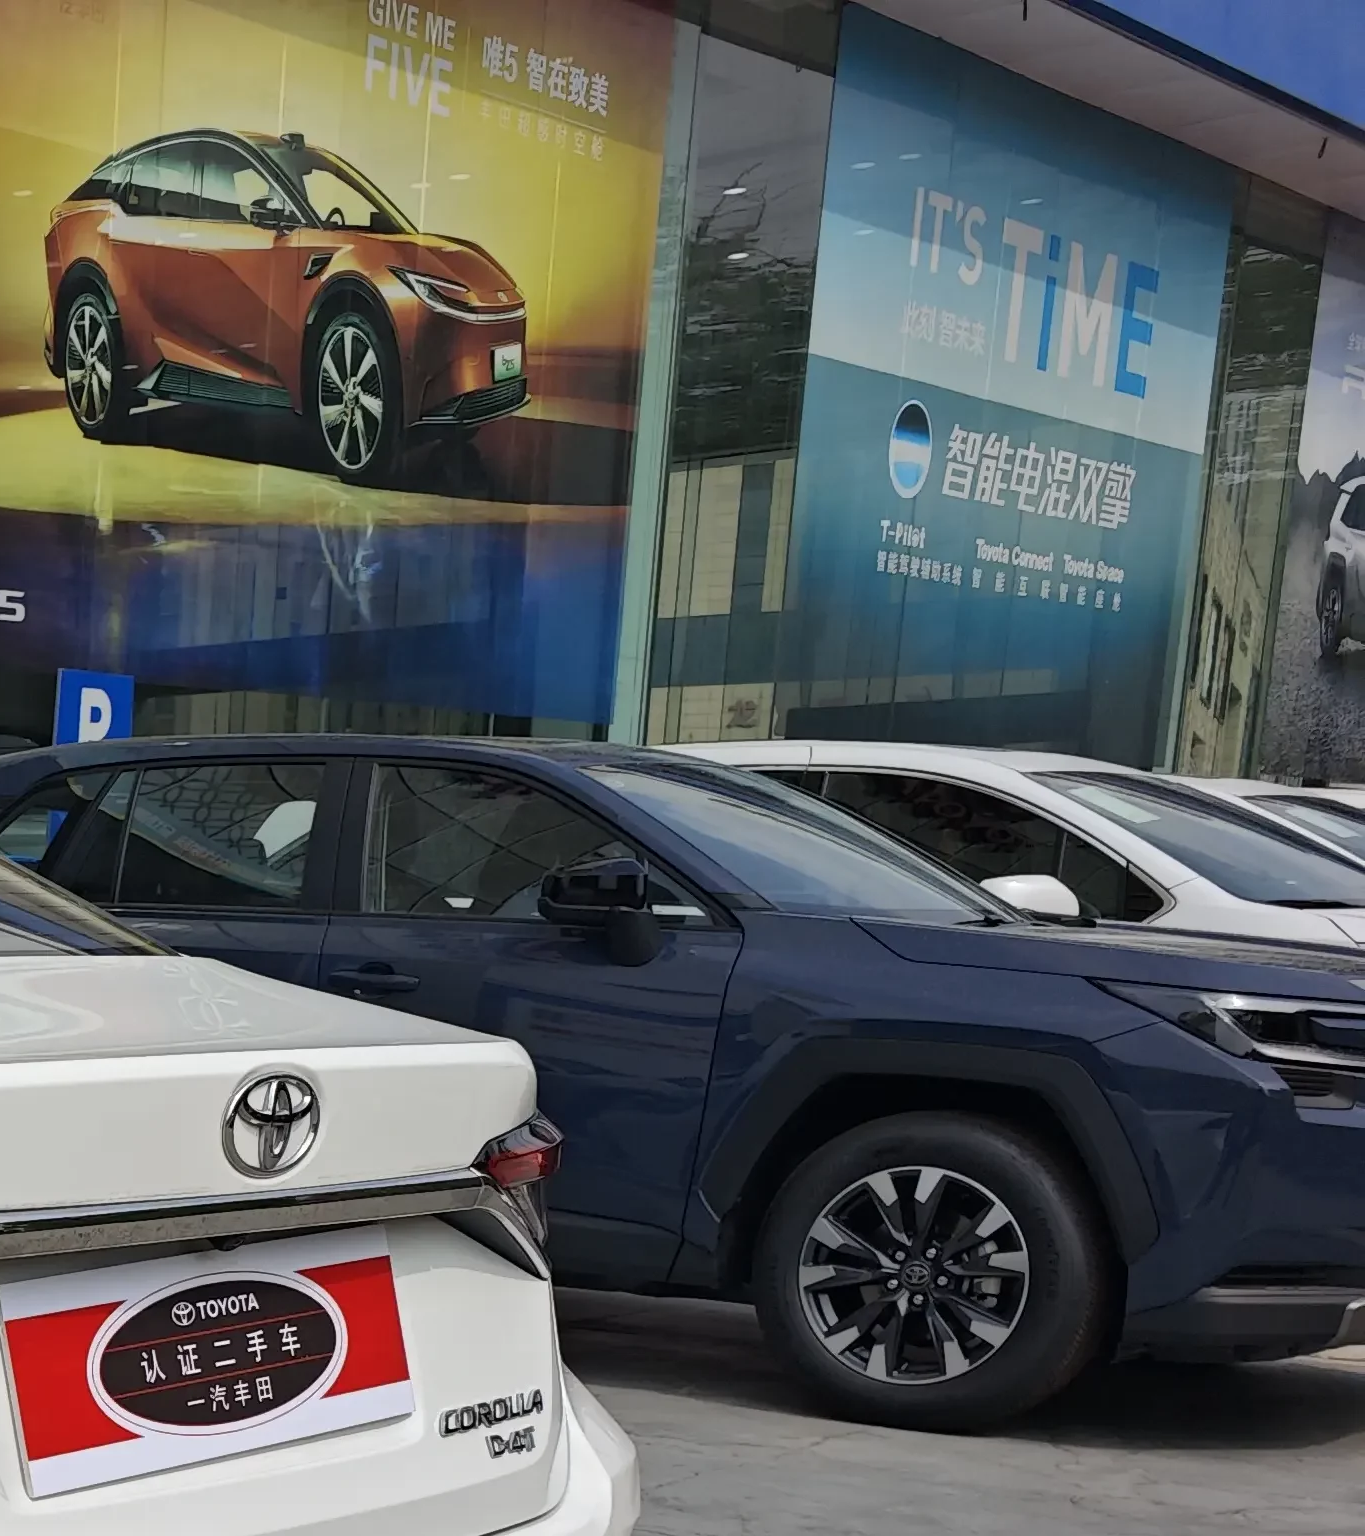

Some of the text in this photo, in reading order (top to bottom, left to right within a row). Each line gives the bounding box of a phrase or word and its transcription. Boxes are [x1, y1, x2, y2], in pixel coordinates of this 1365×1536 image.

[368, 0, 457, 51] GIVE ME
[364, 33, 454, 118] FIVE
[909, 186, 987, 286] IT'S
[941, 423, 1137, 530] 智能电混双擎
[880, 519, 926, 549] T-Pilot
[975, 538, 1055, 573] Toyota Connect
[1063, 553, 1125, 585] Toyota Space
[196, 1292, 260, 1320] TOYOTA
[140, 1322, 301, 1384] 认证二手车
[186, 1376, 274, 1412] 一汽丰田
[438, 1388, 544, 1439] COROLLA
